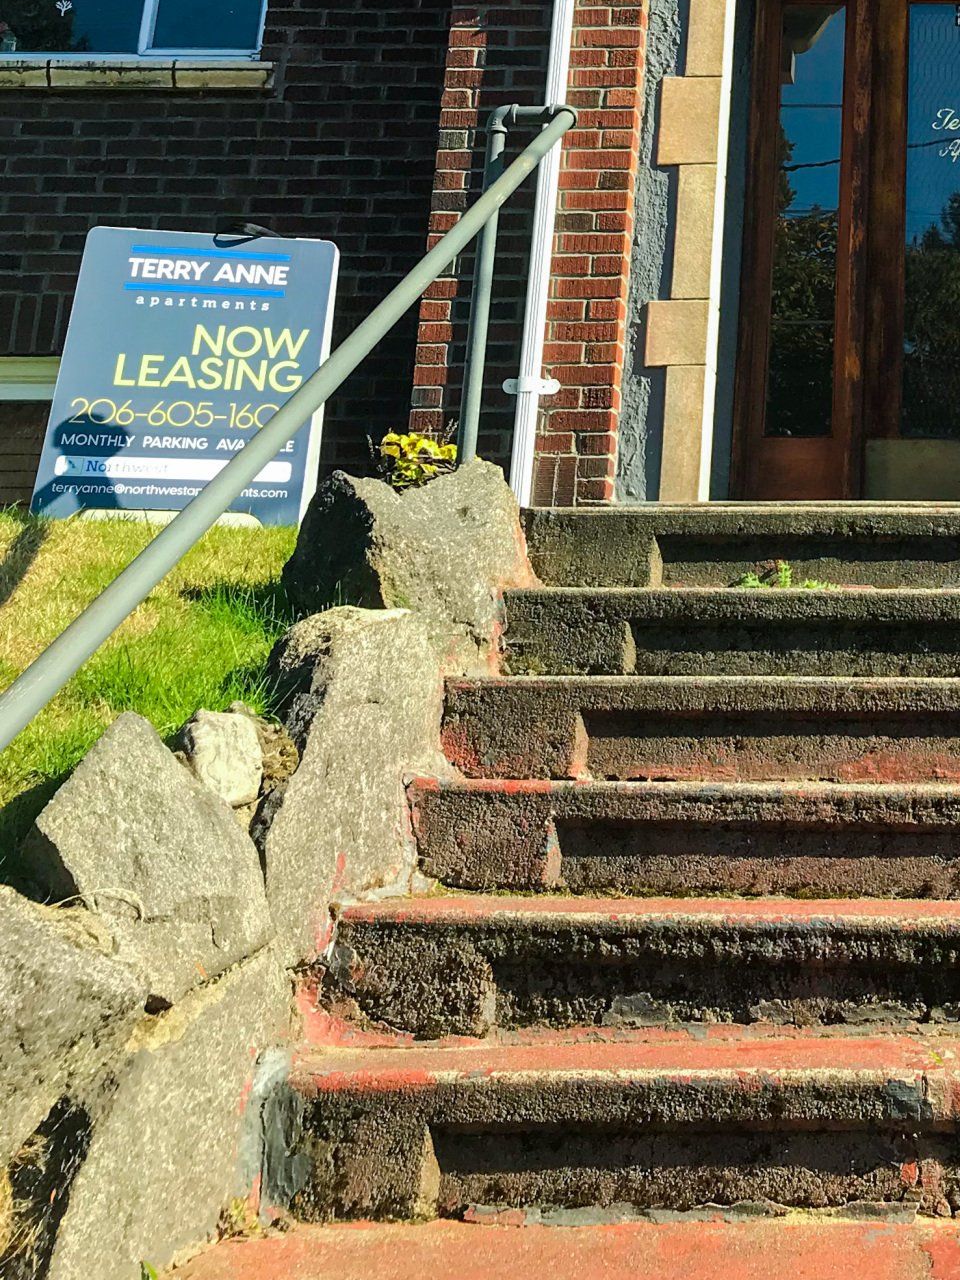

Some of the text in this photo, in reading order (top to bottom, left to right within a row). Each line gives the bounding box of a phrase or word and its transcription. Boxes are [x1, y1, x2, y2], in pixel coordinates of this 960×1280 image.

[128, 257, 290, 286] TERRY ANNE
[135, 295, 271, 311] apartments
[191, 324, 310, 359] NOW
[113, 353, 303, 393] LEASING
[68, 397, 282, 429] 206-605-160
[60, 433, 136, 448] MONTHLY
[142, 435, 209, 450] PARKING
